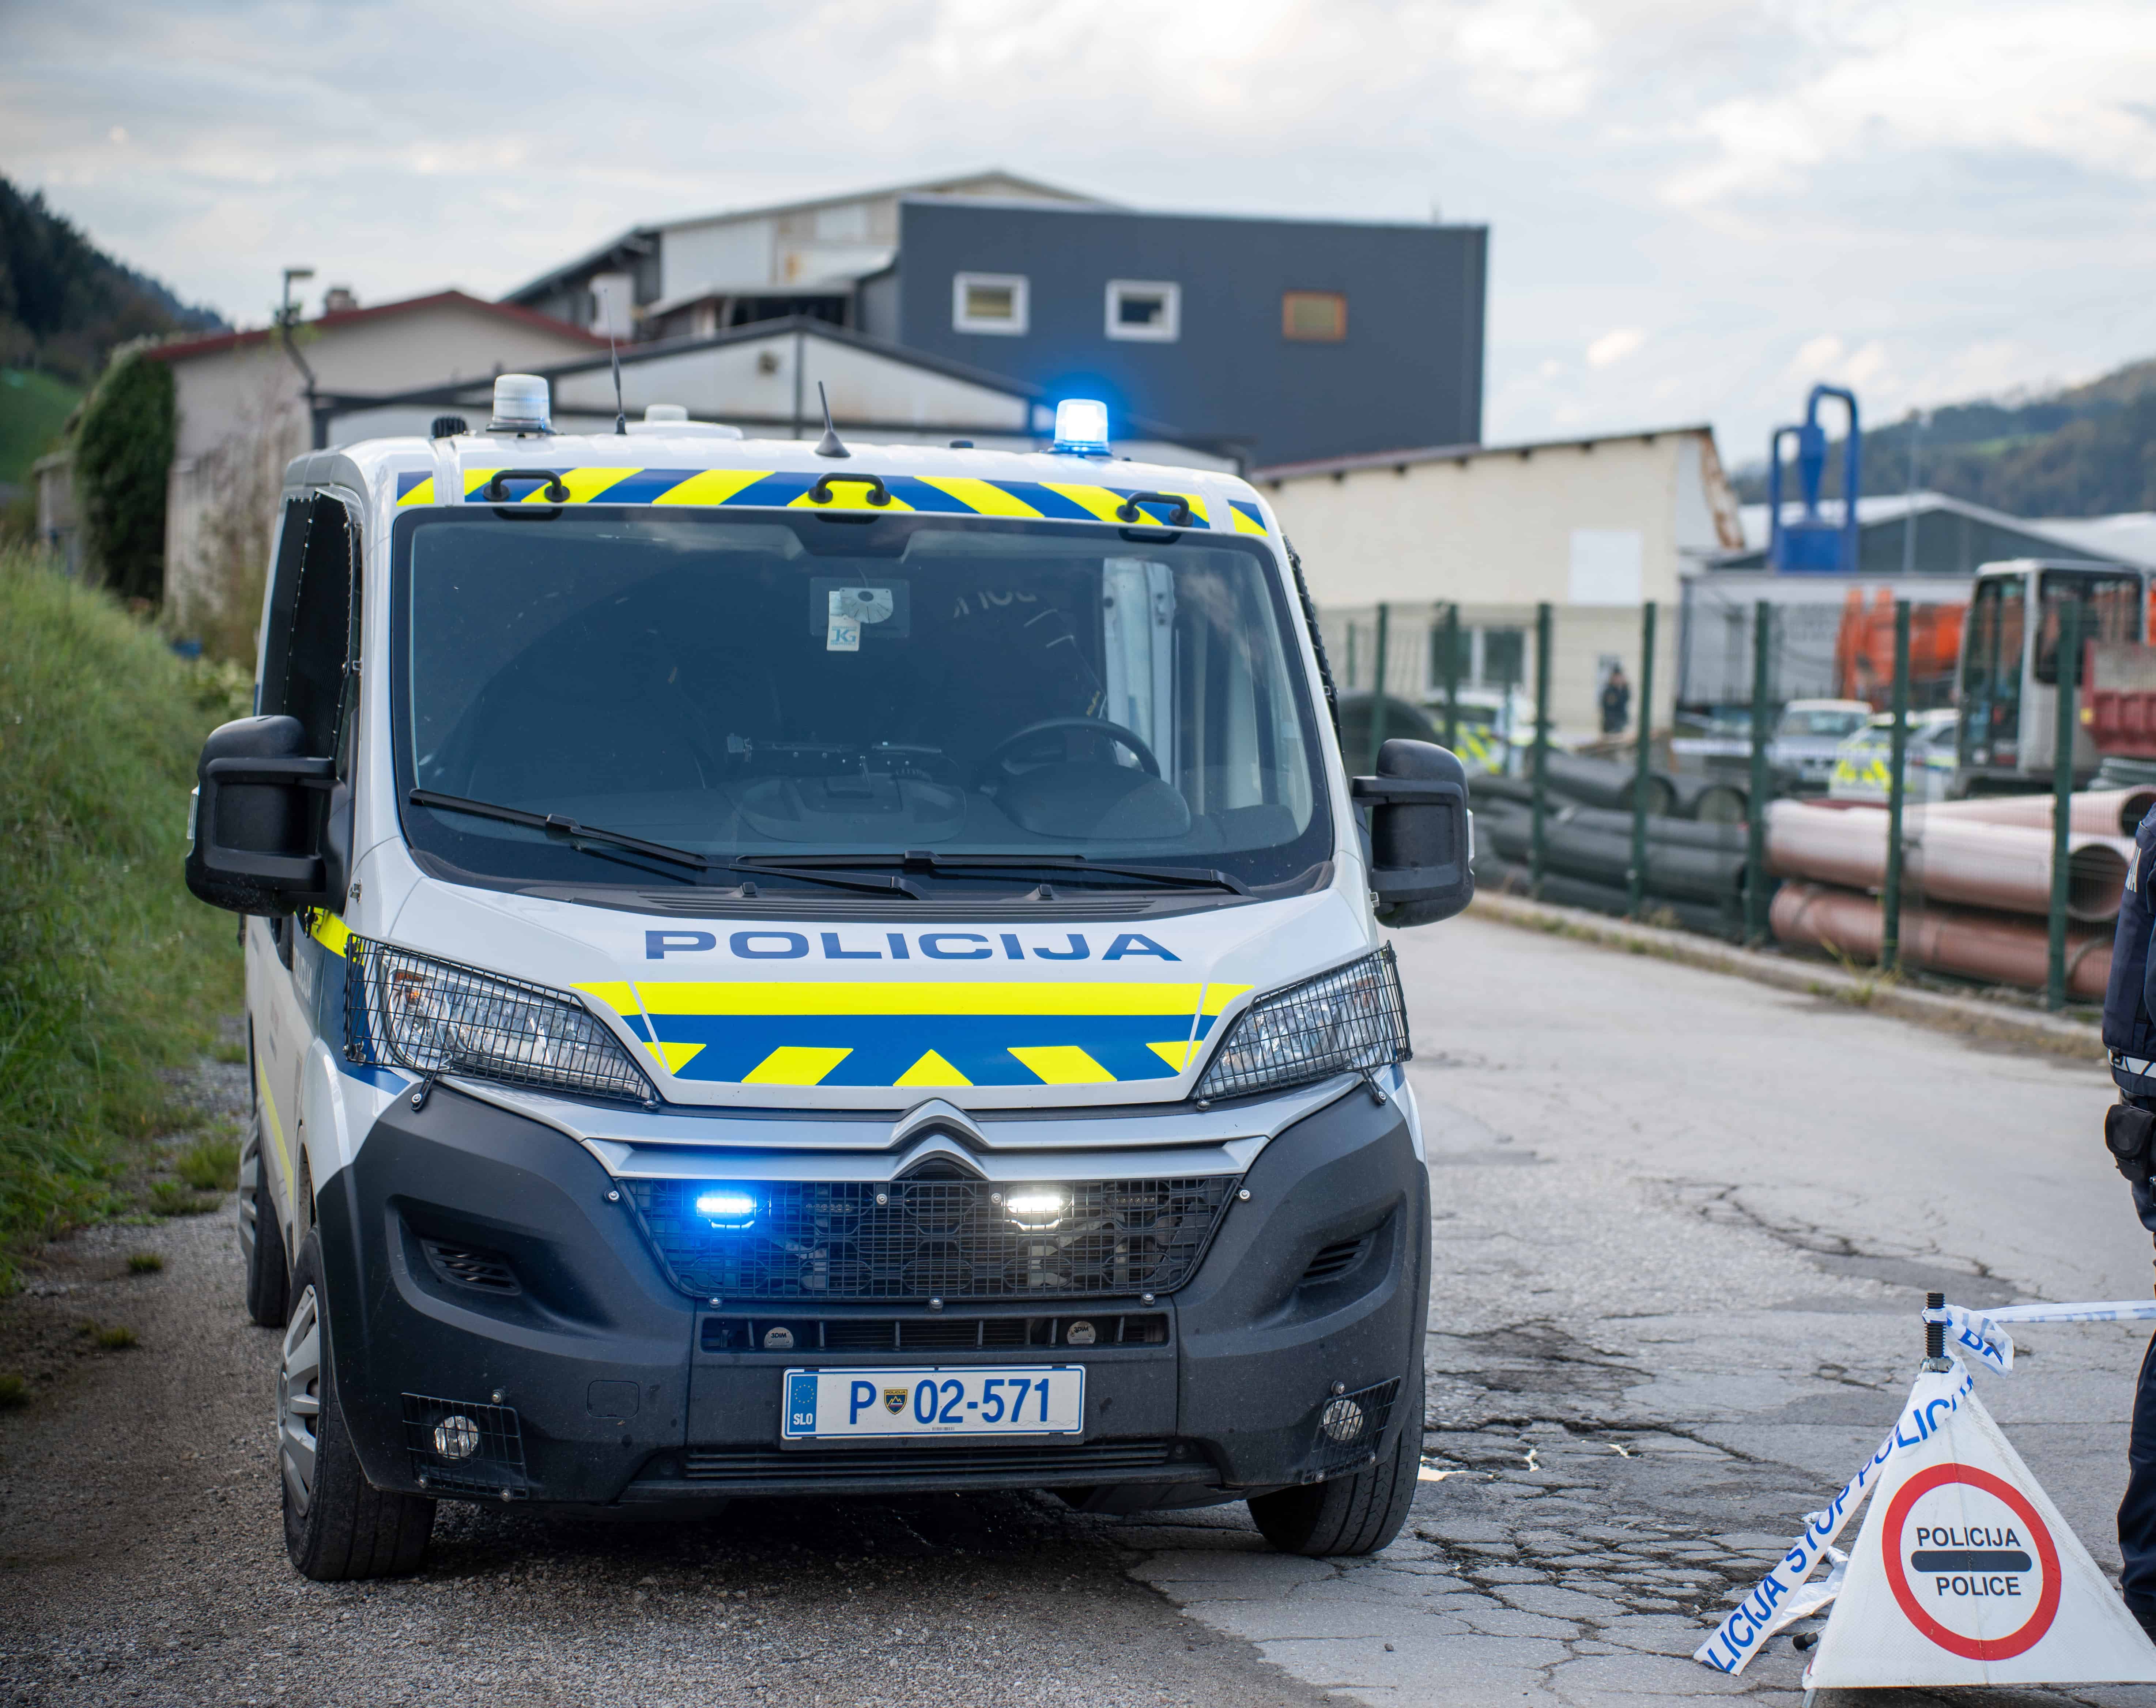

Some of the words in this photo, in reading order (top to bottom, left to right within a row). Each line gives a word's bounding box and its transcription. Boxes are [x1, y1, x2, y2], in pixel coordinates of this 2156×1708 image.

[645, 930, 1182, 961] POLICIJA
[850, 1380, 876, 1424] P
[914, 1378, 1049, 1424] 02-571
[793, 1413, 813, 1425] SLO
[1916, 1527, 2021, 1547] POLICIJA
[1936, 1576, 2021, 1596] POLICE
